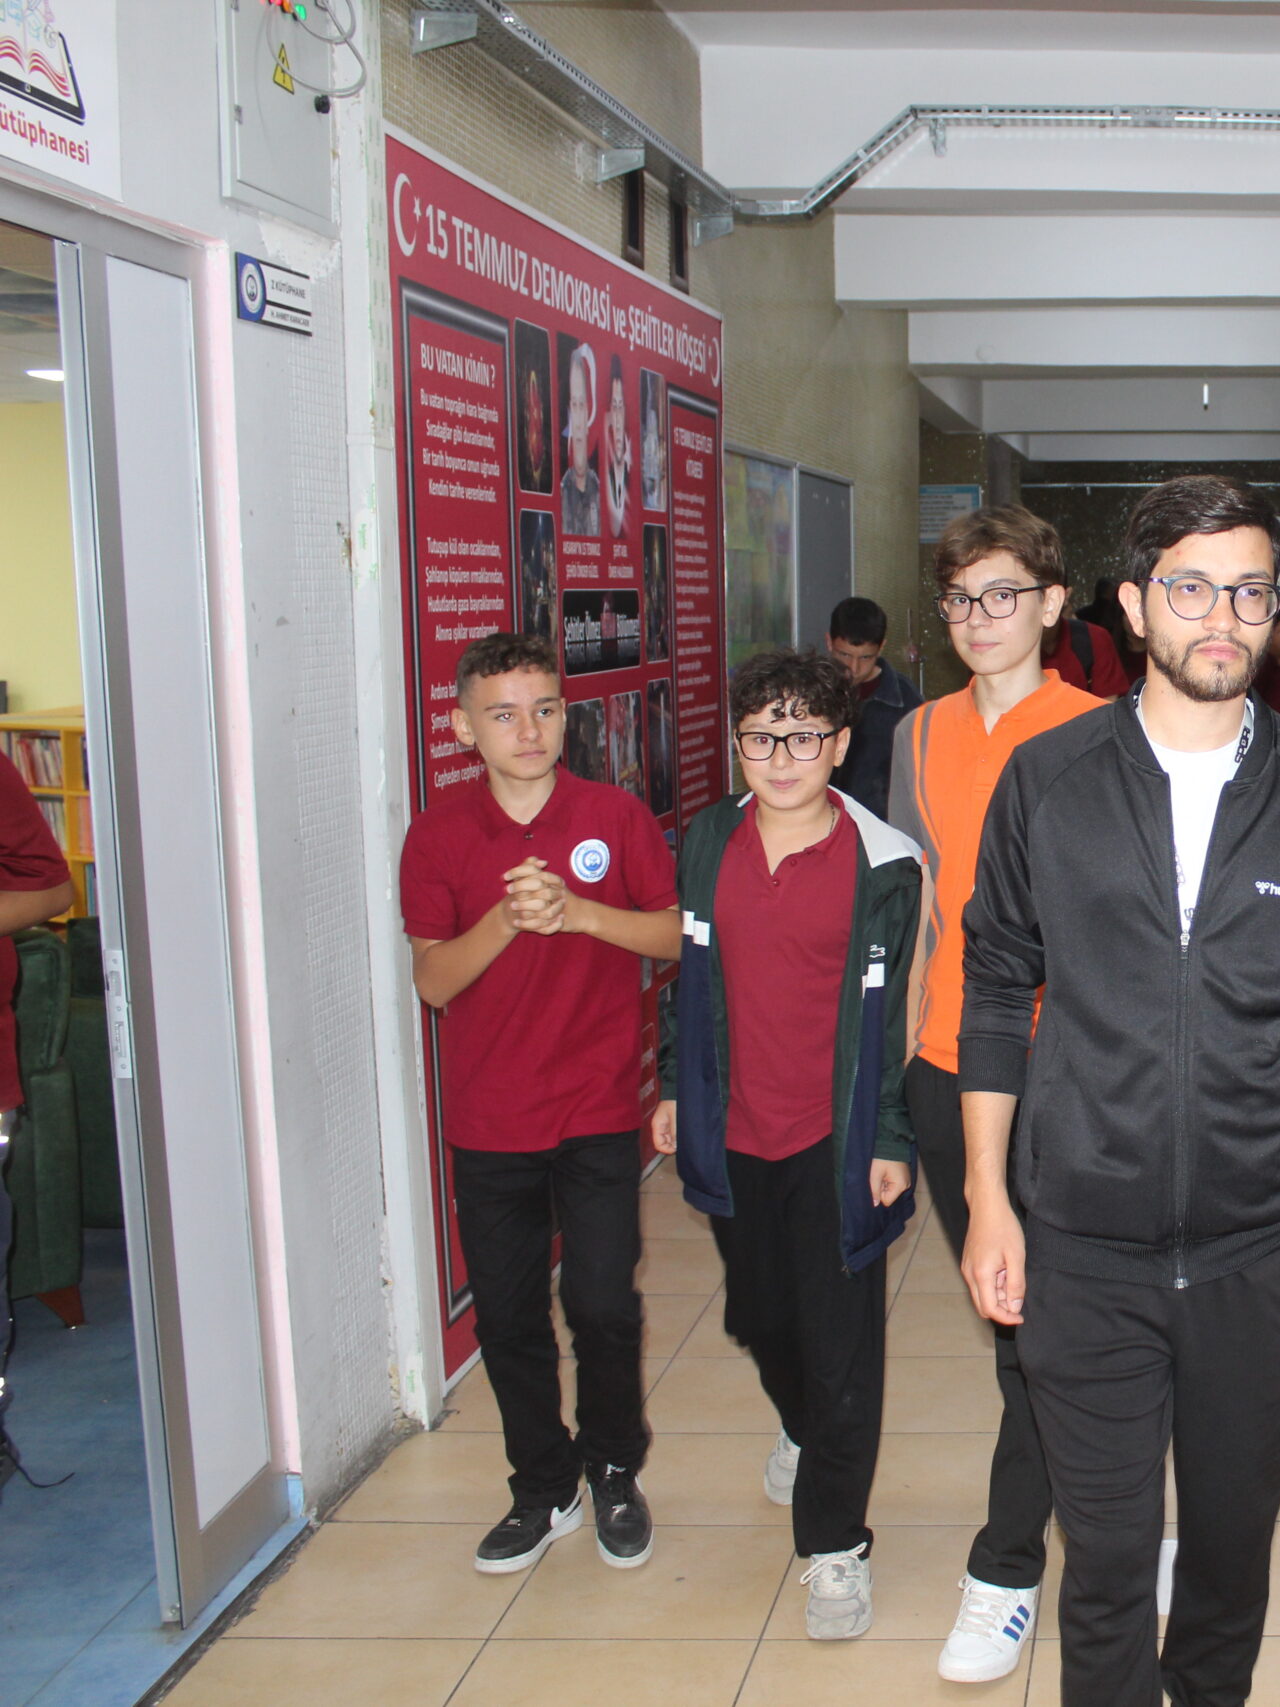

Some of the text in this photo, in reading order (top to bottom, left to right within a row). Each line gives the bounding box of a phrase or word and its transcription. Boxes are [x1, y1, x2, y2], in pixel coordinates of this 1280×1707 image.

[425, 204, 707, 377] 15 TEMMUZ DEMOKRASİ ve ŞEHİTLER KÖŞESİ
[420, 343, 496, 389] BU VATAN KİMİN ?
